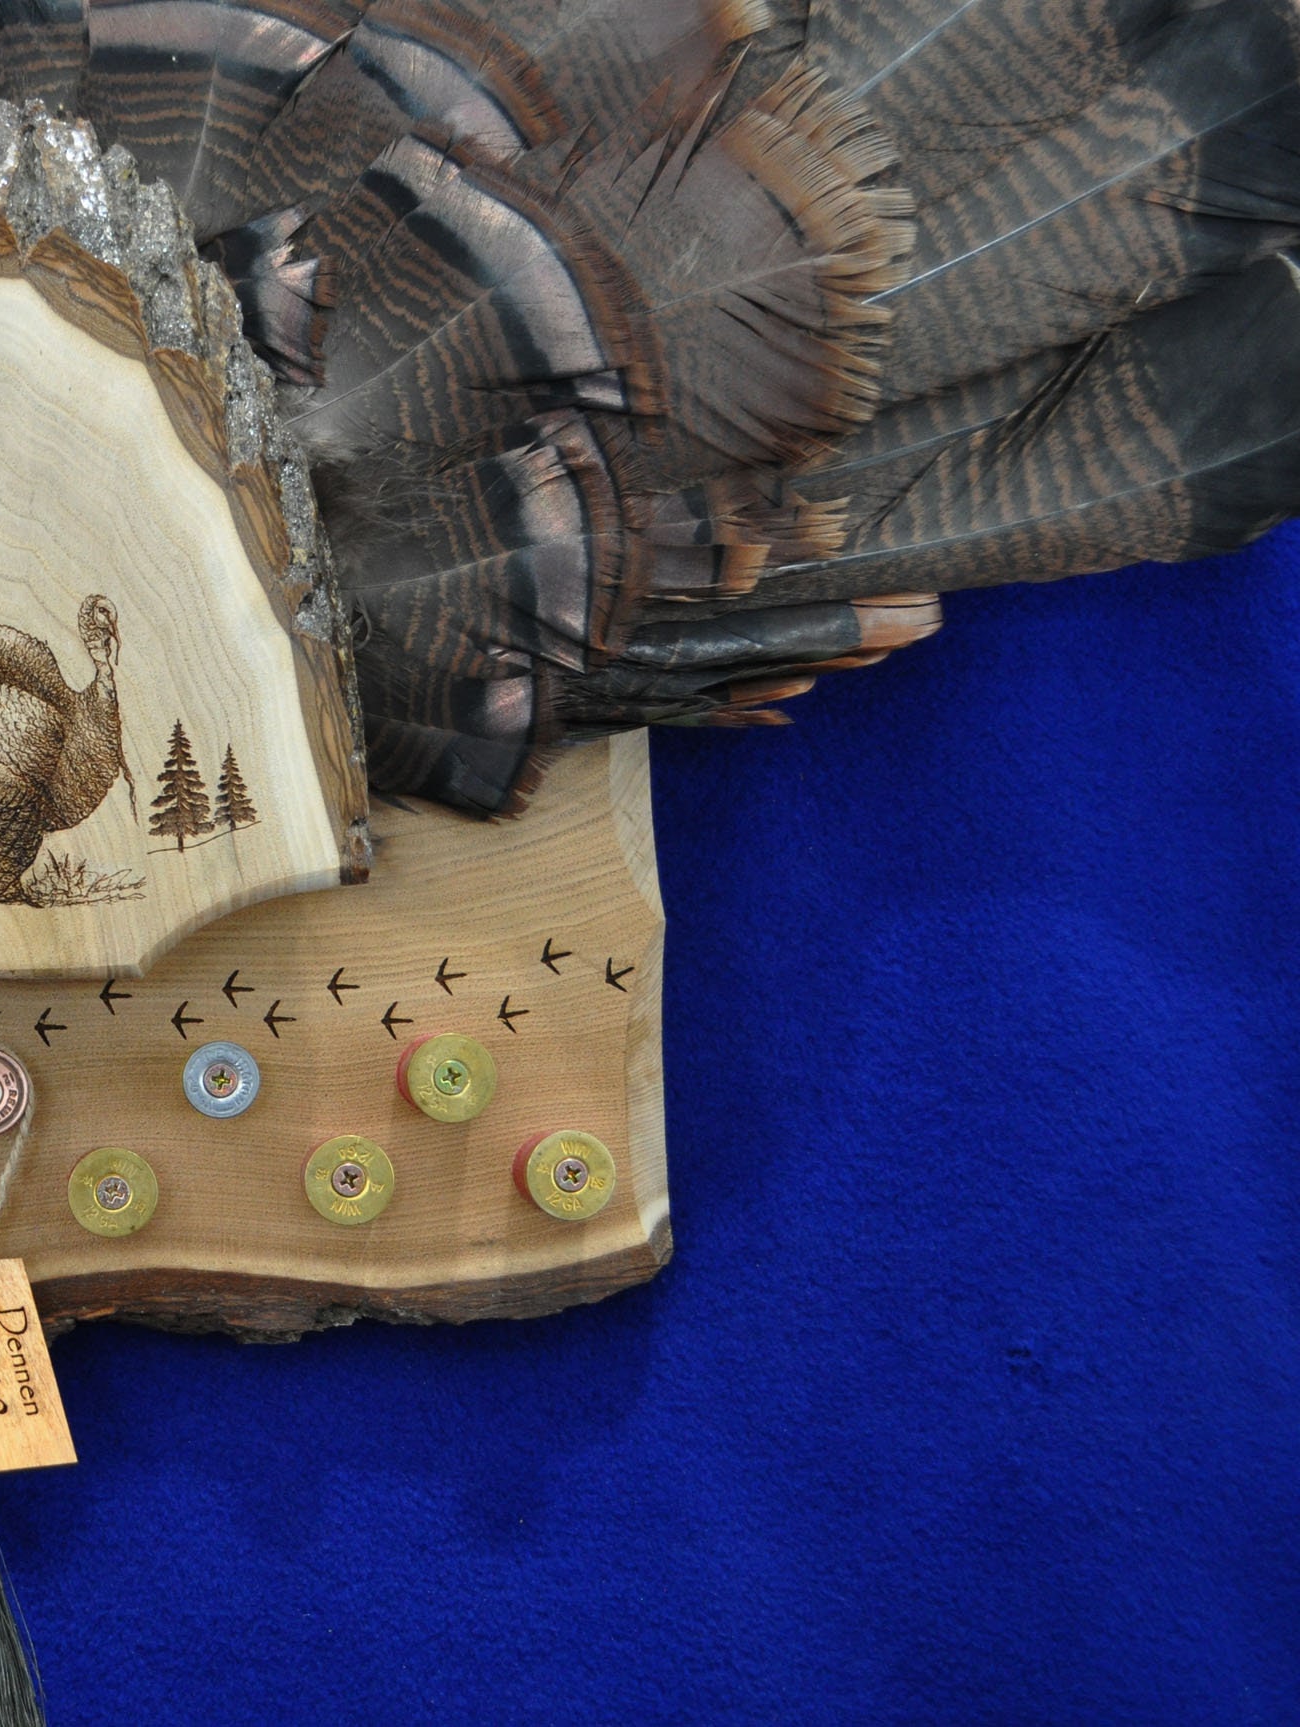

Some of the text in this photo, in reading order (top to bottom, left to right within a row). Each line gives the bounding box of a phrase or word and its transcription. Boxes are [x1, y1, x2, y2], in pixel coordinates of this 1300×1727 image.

[560, 1140, 592, 1158] WIN
[545, 1191, 584, 1212] 12 GA
